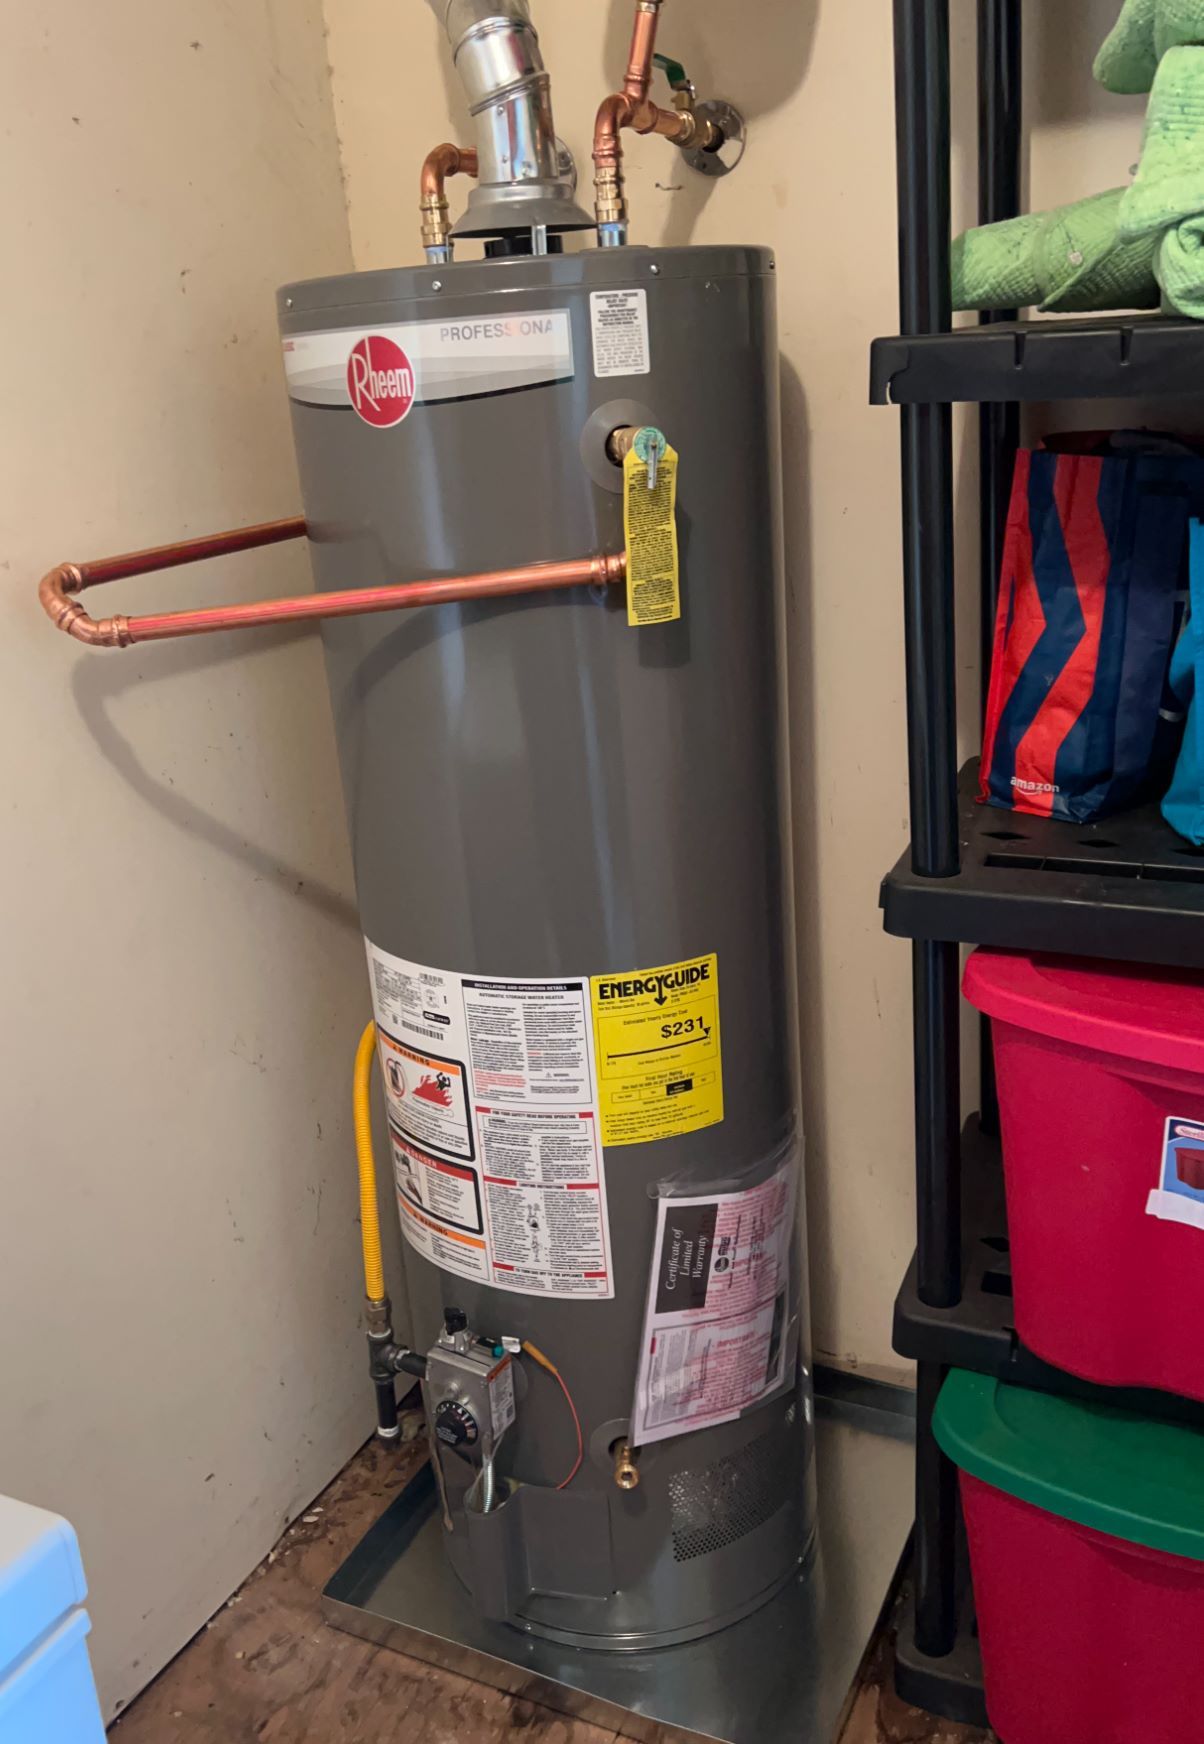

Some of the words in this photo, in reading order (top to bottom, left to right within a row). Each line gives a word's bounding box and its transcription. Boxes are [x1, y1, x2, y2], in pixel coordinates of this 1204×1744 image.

[351, 336, 412, 411] Rheem
[1010, 776, 1060, 793] amazon
[598, 963, 710, 1001] ENERGYGUIDE
[661, 1016, 704, 1039] $231
[671, 1227, 683, 1239] of
[665, 1240, 681, 1290] Certificate
[680, 1240, 693, 1276] Limited
[692, 1235, 709, 1278] Warranty
